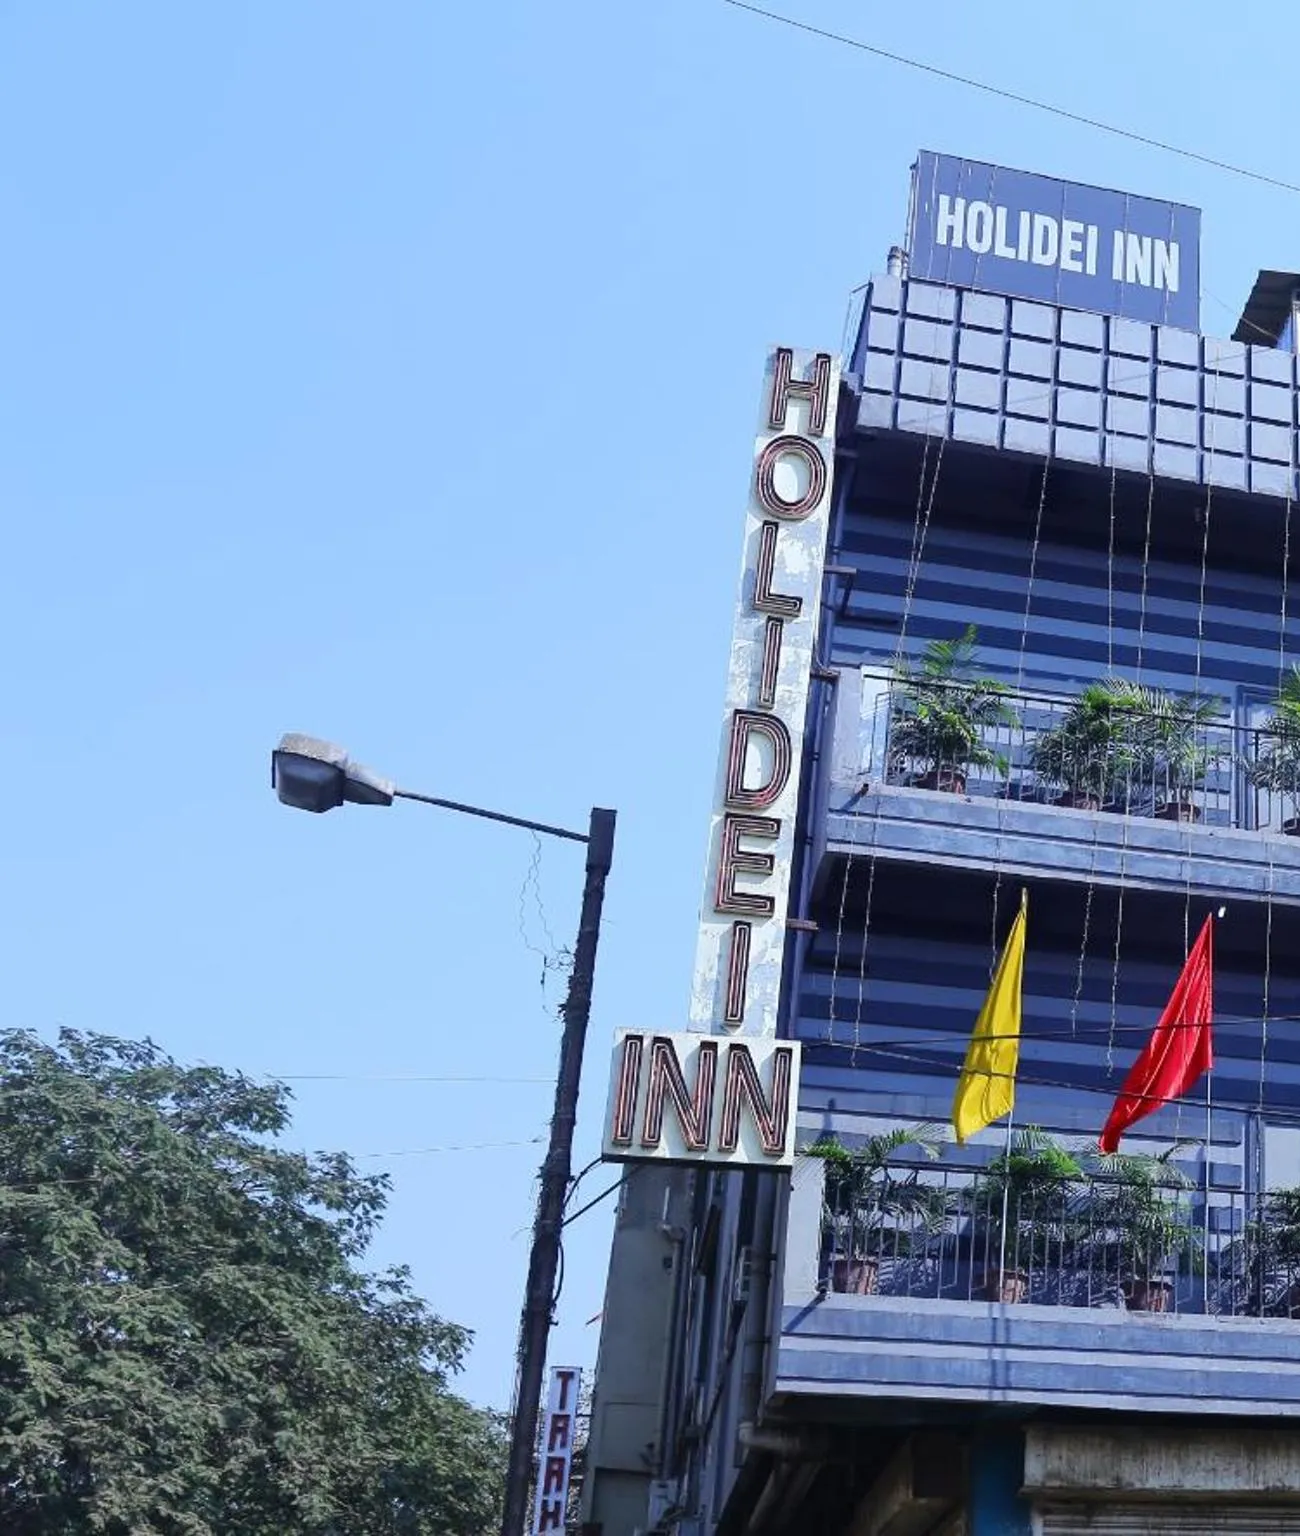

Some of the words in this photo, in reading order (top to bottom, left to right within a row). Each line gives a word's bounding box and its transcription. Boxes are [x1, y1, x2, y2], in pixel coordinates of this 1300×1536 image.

[936, 194, 1098, 275] HOLIDEI
[1112, 230, 1178, 292] INN
[714, 347, 831, 1025] HOLIDEI
[612, 1034, 792, 1154] INN
